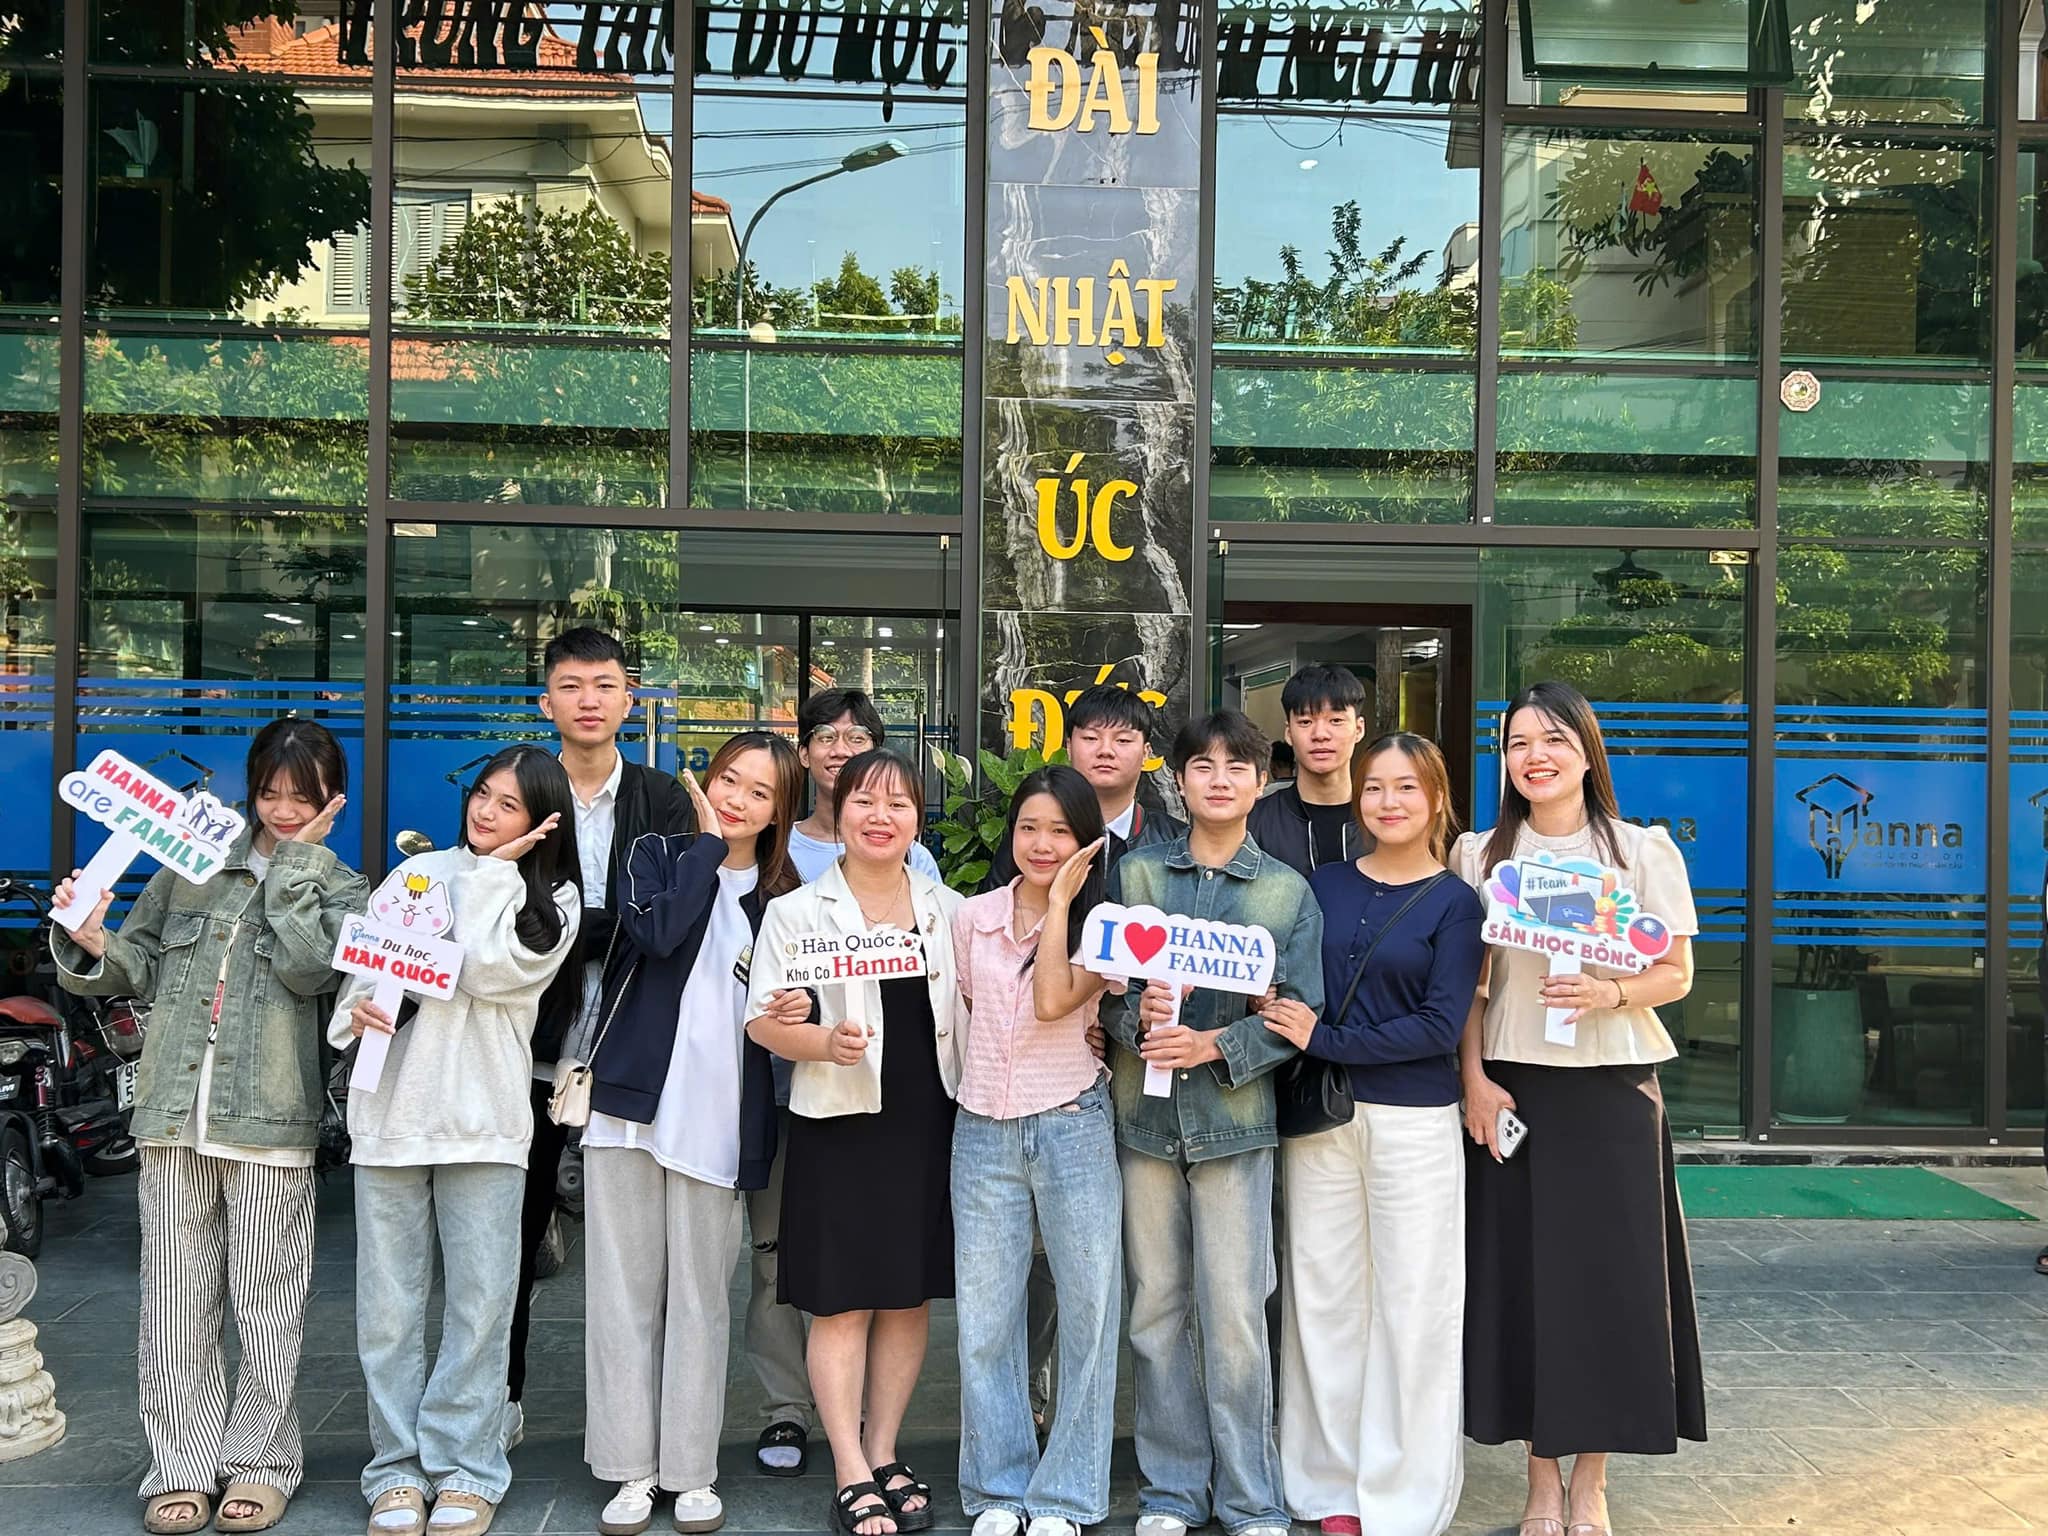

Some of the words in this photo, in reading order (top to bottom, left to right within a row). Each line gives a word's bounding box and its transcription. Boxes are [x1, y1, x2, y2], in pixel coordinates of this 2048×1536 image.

[1025, 26, 1160, 134] ĐÀI
[1006, 259, 1178, 366] NHẬT
[1035, 452, 1139, 562] ÚC
[96, 759, 177, 820] HANNA
[69, 780, 112, 813] are
[113, 806, 215, 876] FAMILY
[1525, 876, 1569, 890] #Team
[381, 939, 402, 953] Du
[404, 944, 432, 961] học
[801, 938, 840, 954] Hàn
[845, 930, 895, 952] Quốc
[1095, 919, 1119, 961] I
[1168, 926, 1265, 958] HANNA
[1487, 921, 1527, 945] SĂN
[1531, 932, 1575, 956] HỌC
[342, 944, 386, 971] HÀN
[391, 961, 451, 990] QUỐC
[832, 955, 920, 978] Hanna
[1168, 952, 1262, 982] FAMILY
